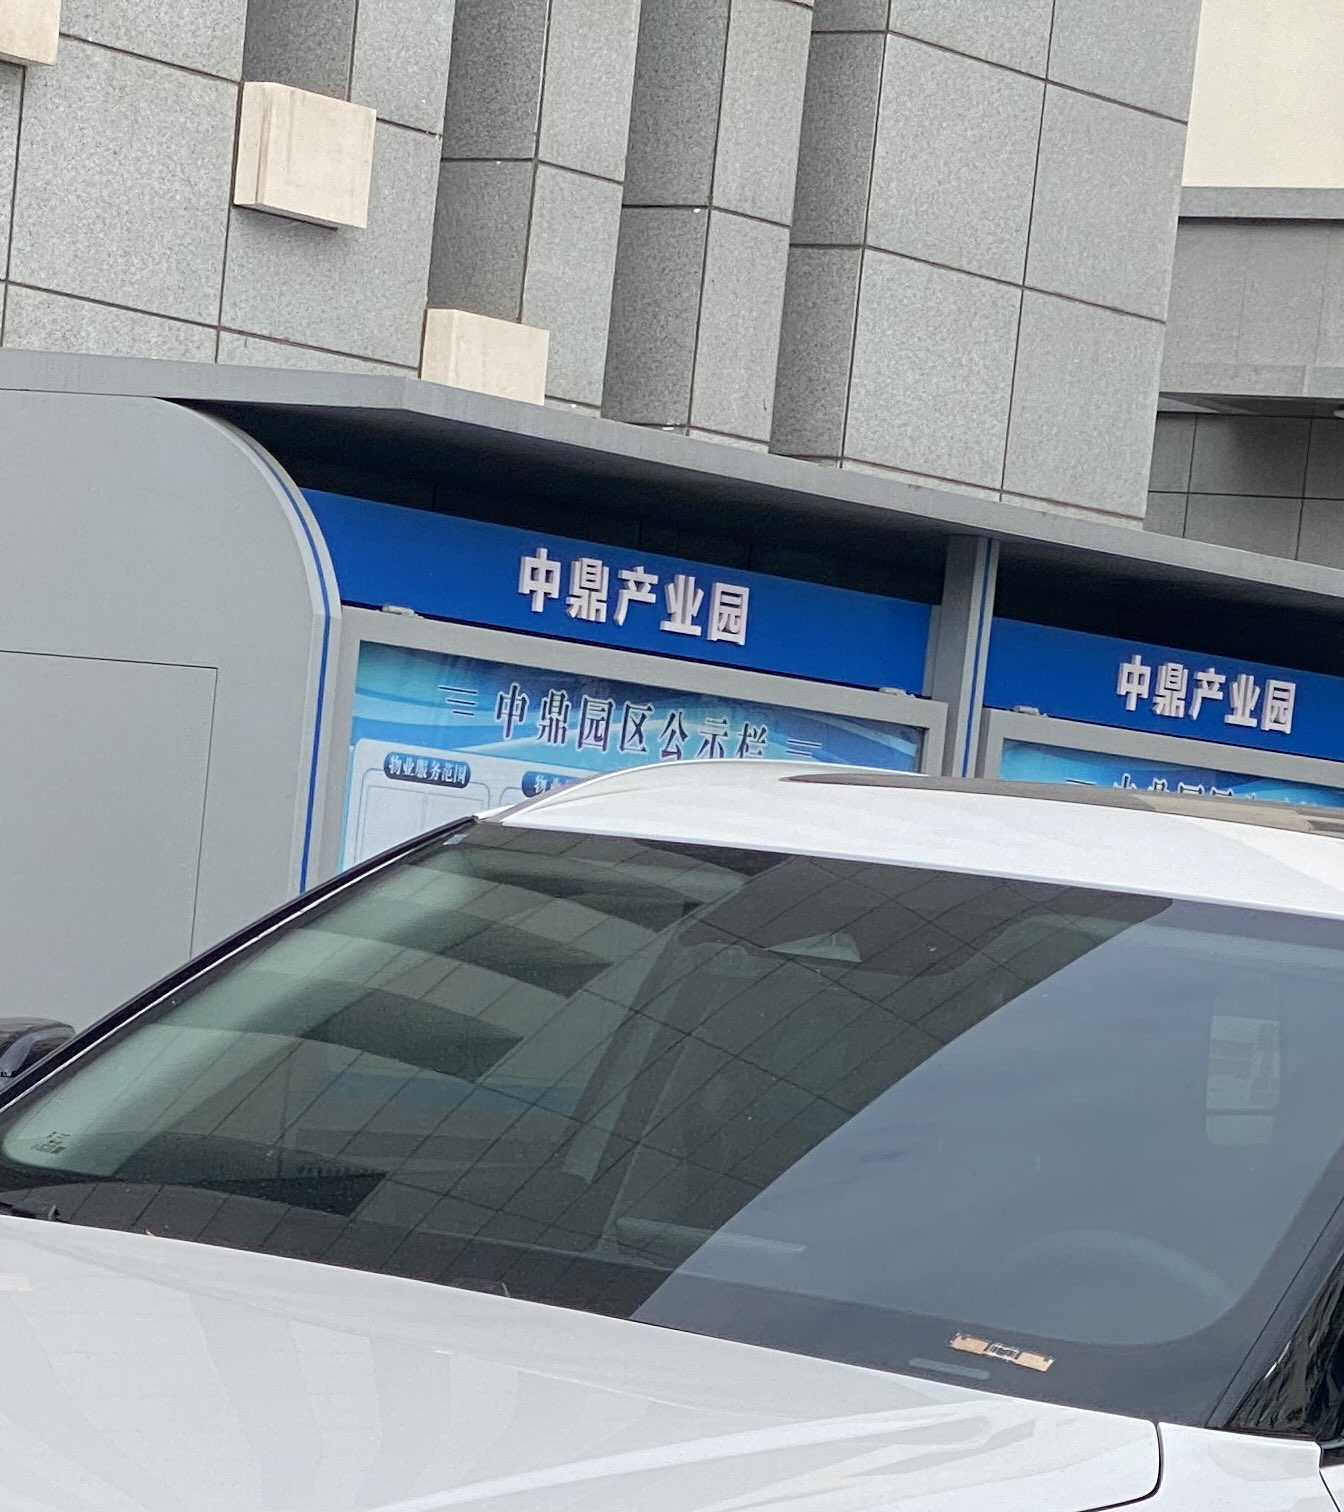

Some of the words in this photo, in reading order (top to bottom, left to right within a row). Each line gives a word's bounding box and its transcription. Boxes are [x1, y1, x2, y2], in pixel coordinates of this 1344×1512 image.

[518, 548, 750, 646] 中鼎产业园
[495, 683, 769, 758] 中鼎园区公示栏
[1116, 655, 1296, 734] 中鼎产业园
[388, 754, 467, 785] 物业服务范围
